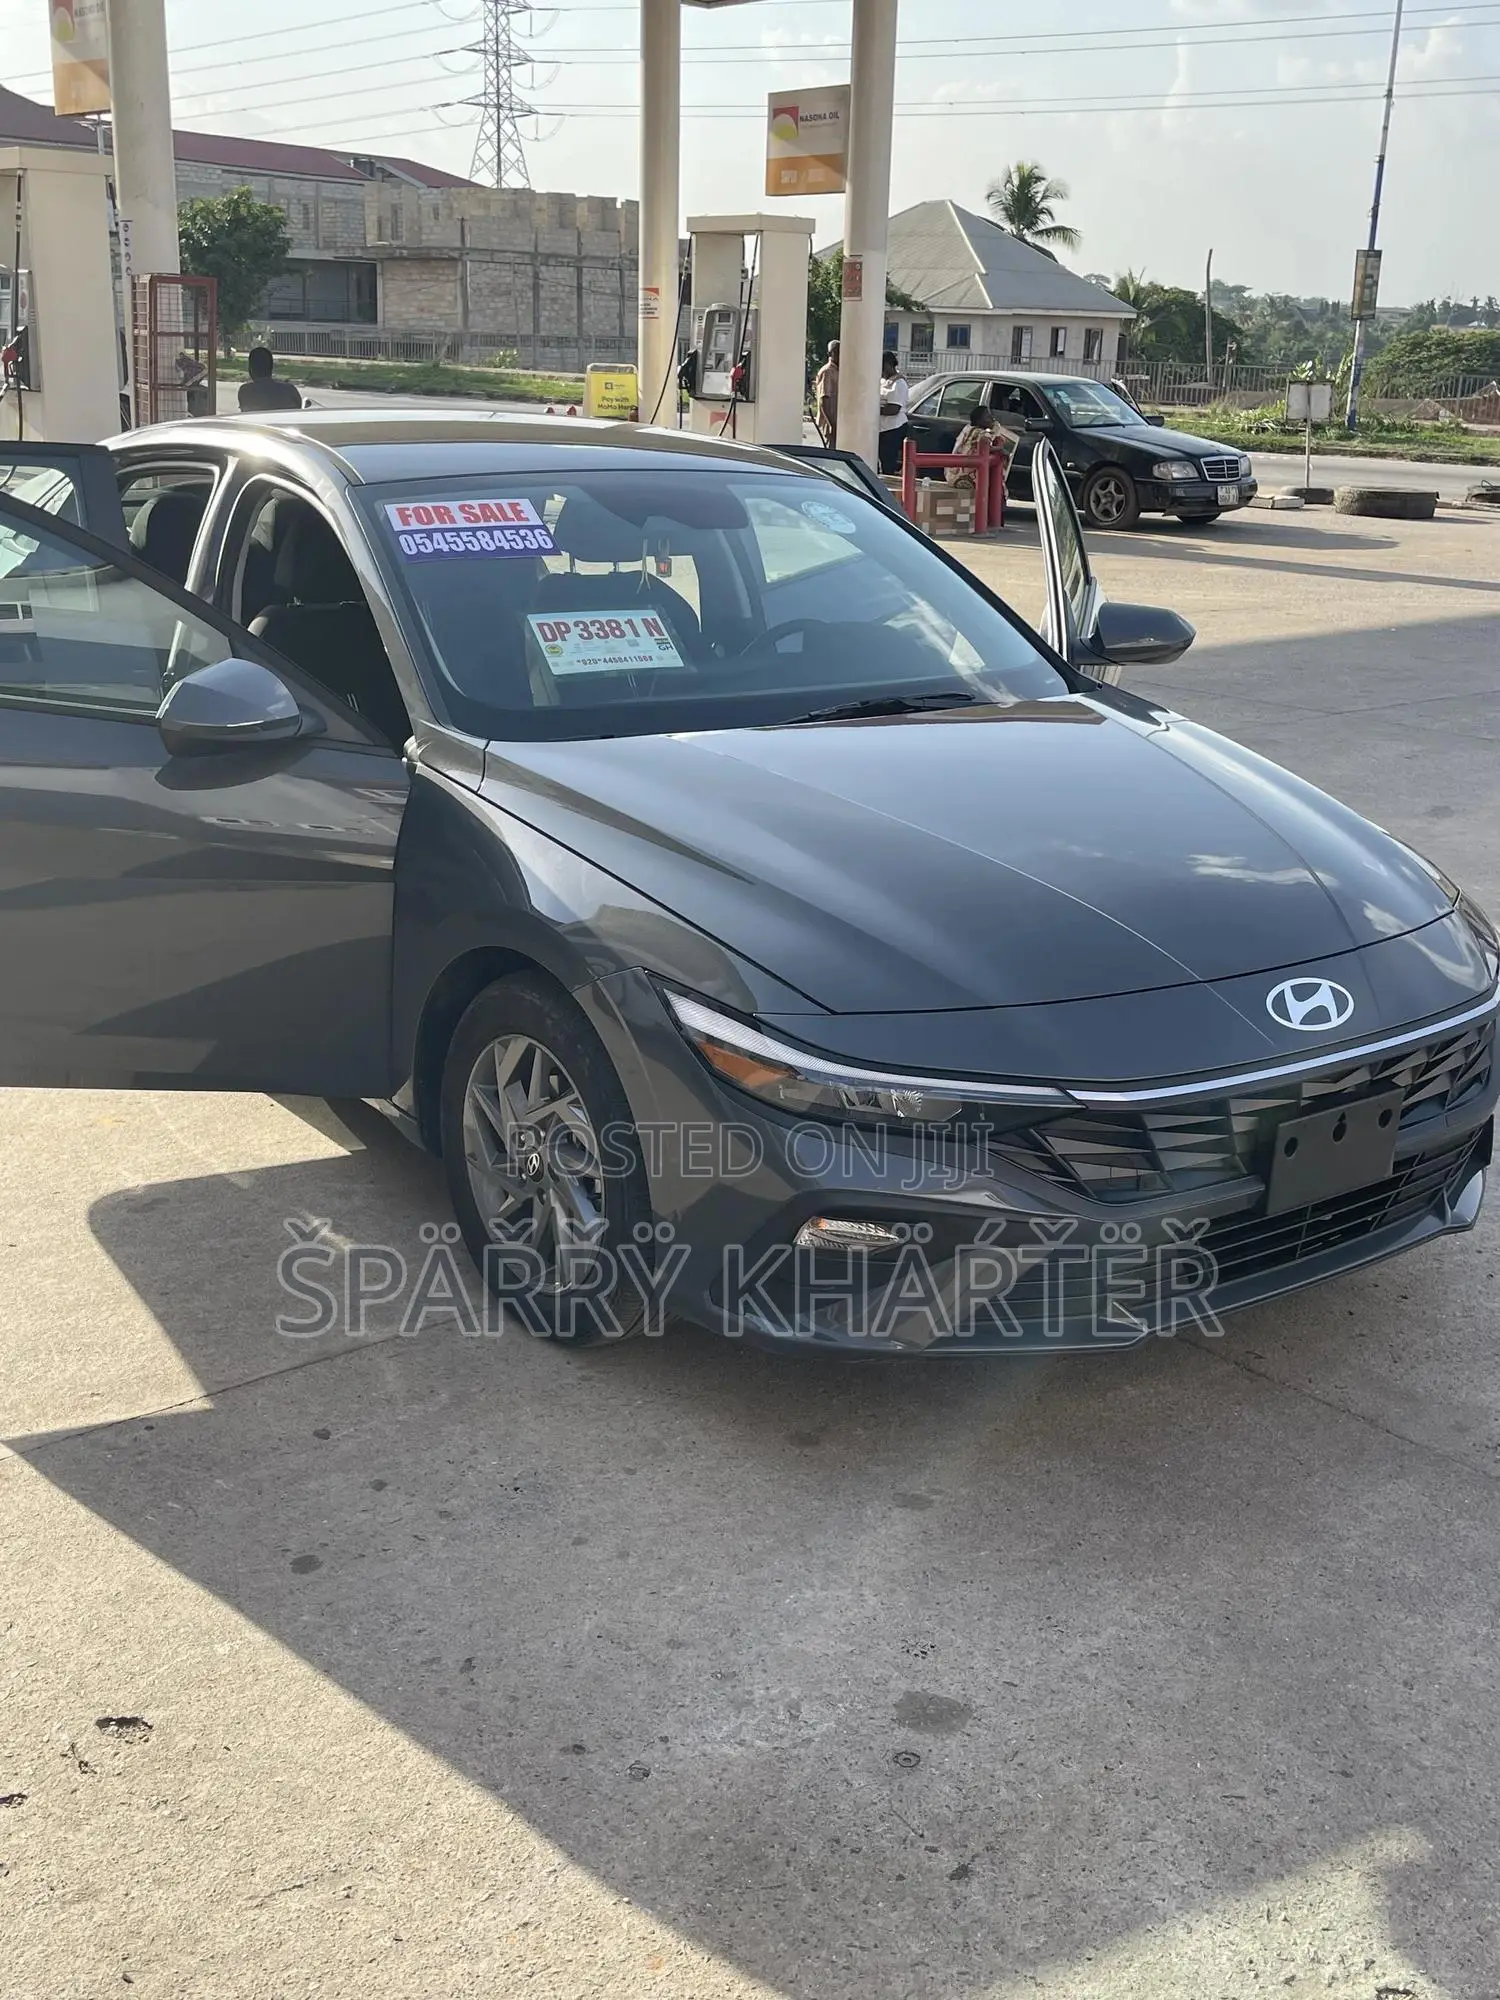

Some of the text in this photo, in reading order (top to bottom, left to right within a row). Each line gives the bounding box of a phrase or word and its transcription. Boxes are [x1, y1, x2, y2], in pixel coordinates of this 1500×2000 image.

[829, 111, 840, 120] OIL
[396, 502, 529, 526] FOR SALE
[399, 529, 554, 555] 0545584536
[536, 618, 665, 642] DP 3381 N
